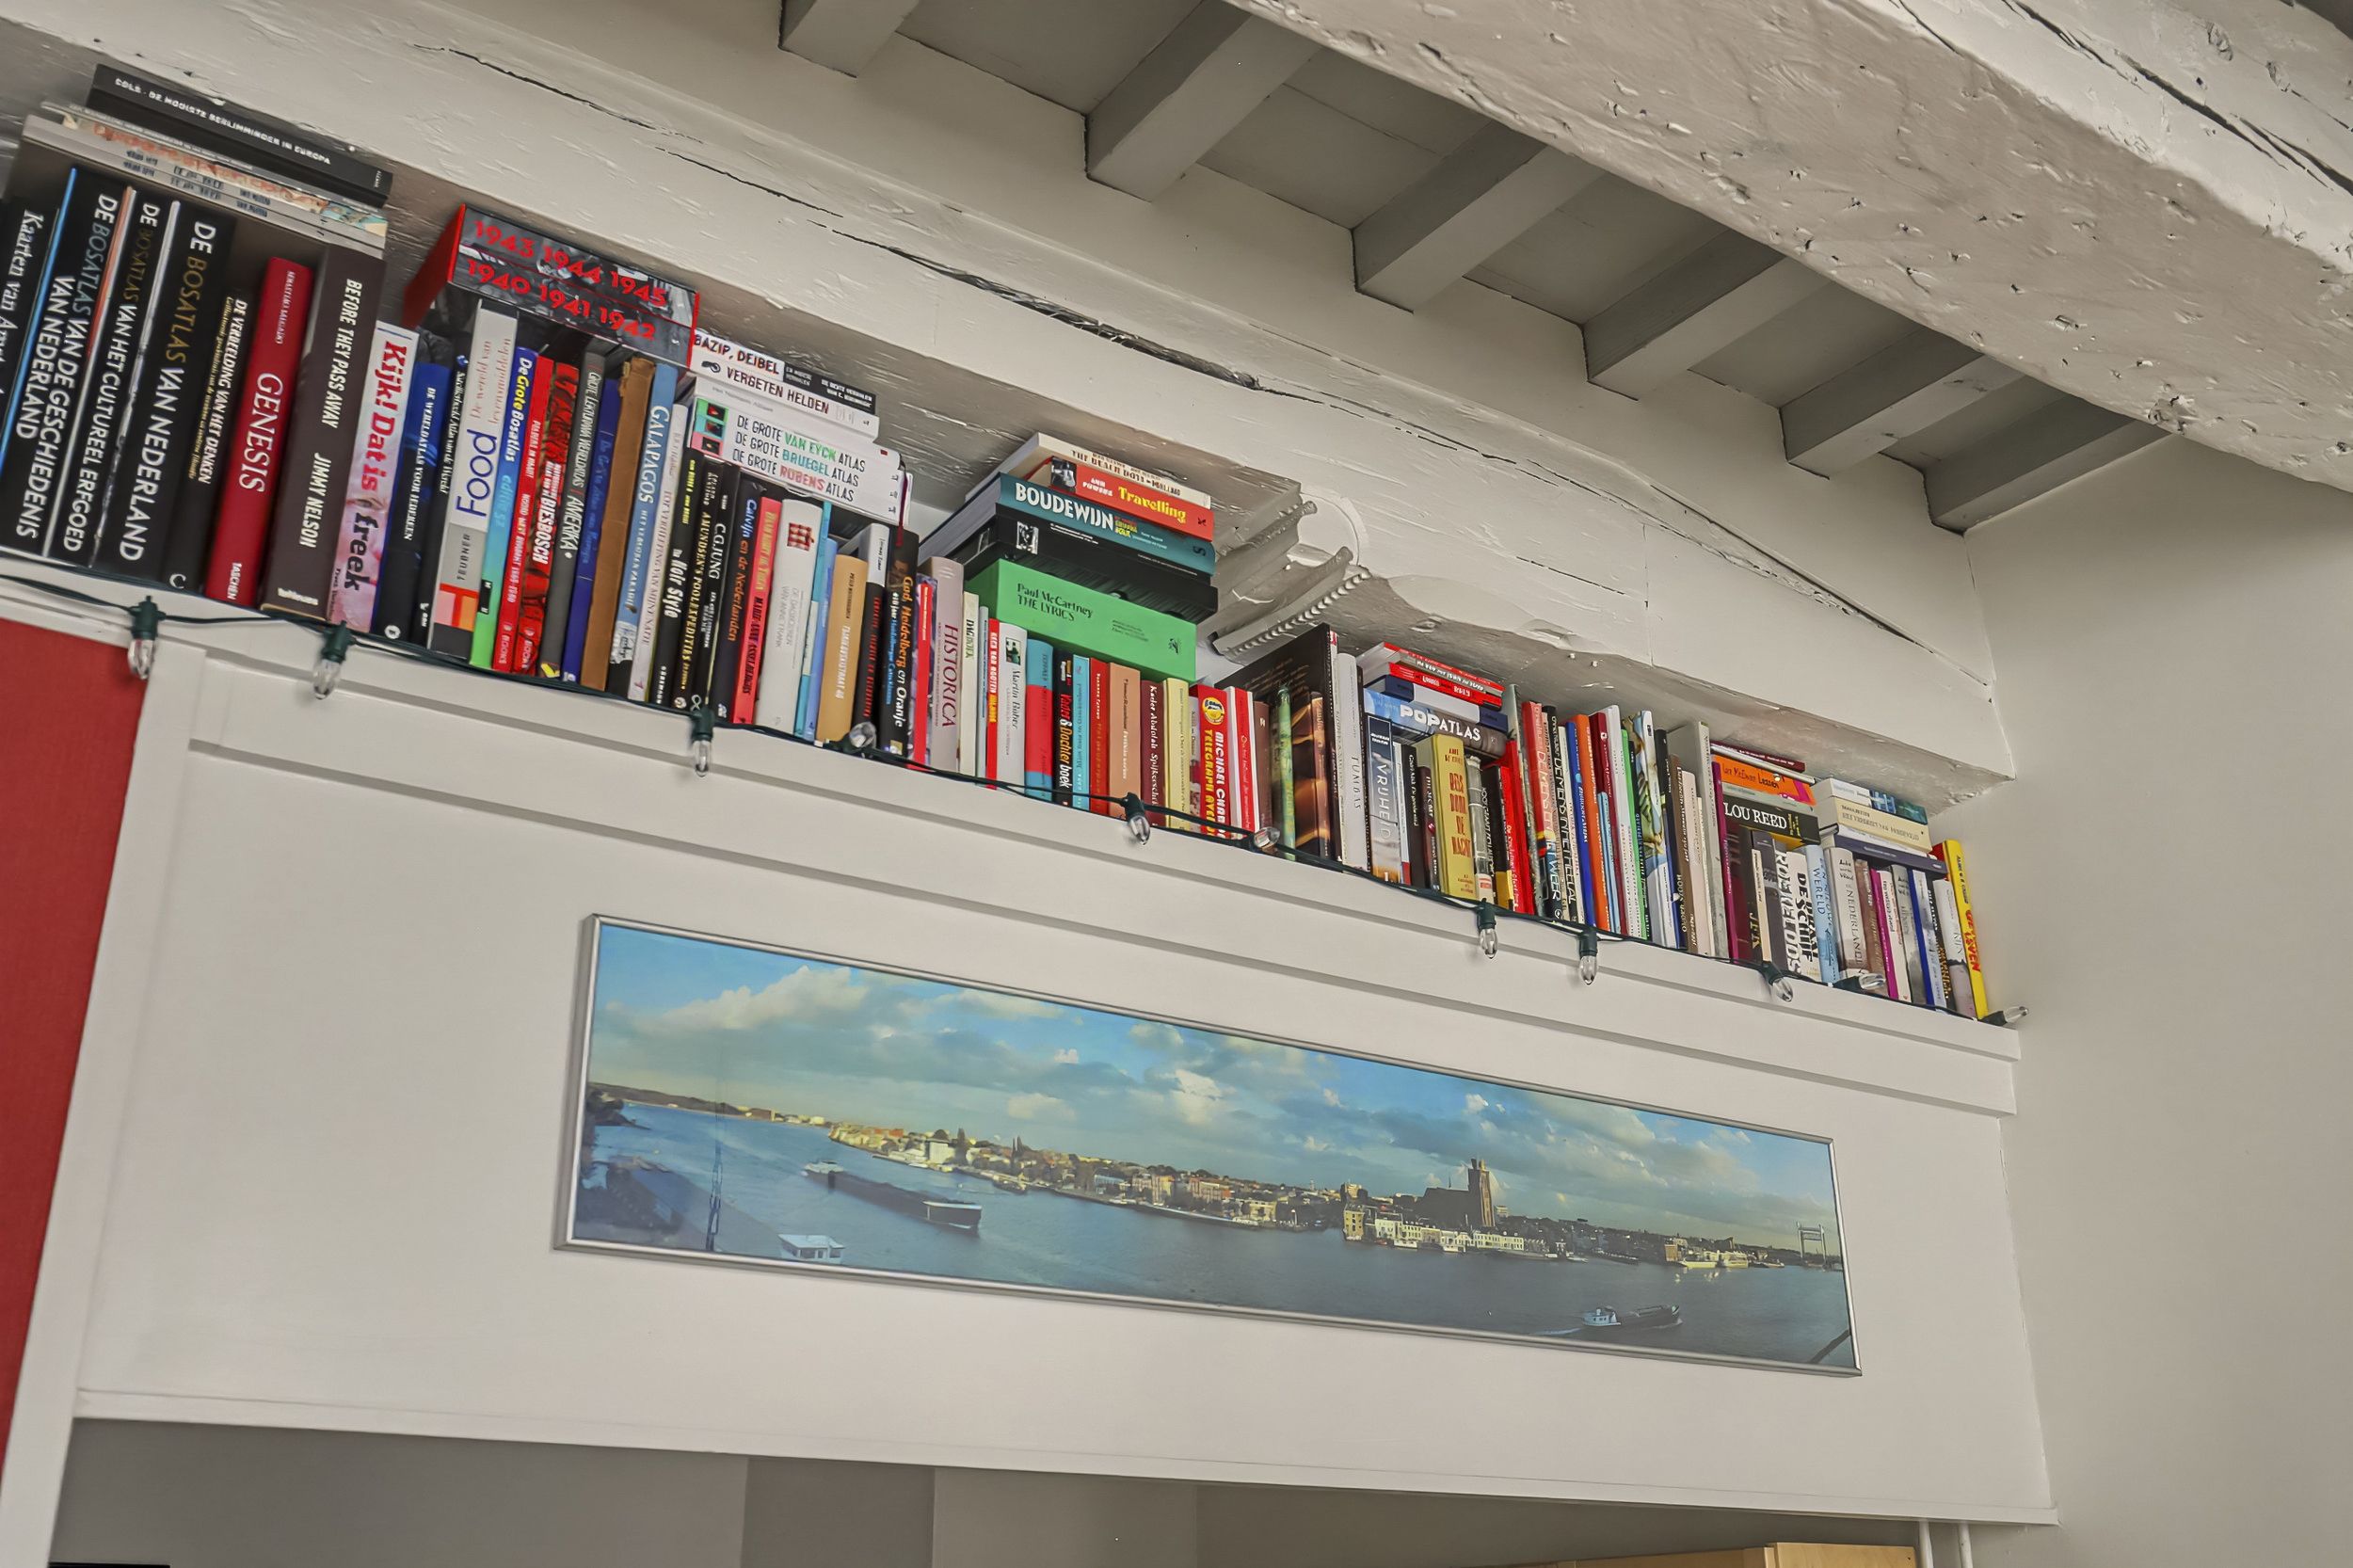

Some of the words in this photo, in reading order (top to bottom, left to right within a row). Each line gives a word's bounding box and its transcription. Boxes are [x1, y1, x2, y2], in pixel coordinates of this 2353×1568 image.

[294, 143, 331, 166] EUROPA
[94, 193, 118, 224] DE
[140, 202, 161, 228] DE
[8, 209, 44, 277] Kaarten
[189, 220, 216, 254] DE
[72, 222, 111, 316] BOSATLAS
[122, 228, 154, 302] BOSATLAS
[473, 220, 536, 259] 1943
[542, 246, 604, 283] 1944
[610, 269, 669, 308] 1945
[1, 281, 21, 311] van
[48, 275, 76, 314] VAN
[165, 256, 208, 363] BOSATLAS
[233, 298, 248, 314] DE
[340, 279, 362, 326] BEFORE
[467, 259, 532, 295] 1940
[538, 284, 590, 318] 1941
[598, 306, 656, 342] 1942
[62, 318, 90, 359] VAN
[116, 303, 137, 337] VAN
[106, 338, 130, 373] HET
[218, 313, 244, 390] VERBEELDING
[334, 328, 355, 358] THEY
[737, 349, 779, 376] DEIBEL
[16, 316, 64, 440] NEDERLAND
[53, 358, 79, 389] DE
[328, 357, 350, 392] PASS
[375, 341, 408, 411] Kijk!
[474, 363, 488, 400] wereld
[481, 342, 491, 360] van
[488, 338, 511, 424] levensmiddelen
[519, 358, 533, 376] De
[152, 367, 185, 412] VAN
[213, 392, 231, 411] VAN
[322, 391, 343, 428] AWAY
[426, 387, 437, 400] DE
[512, 376, 530, 411] Grote
[727, 366, 784, 398] VERGETEN
[787, 389, 829, 414] HELDEN
[82, 373, 121, 465] CULTUREEL
[209, 410, 225, 437] HET
[238, 373, 283, 493] GENESIS
[366, 412, 396, 462] Dat
[415, 400, 435, 471] WERELDATLAS
[504, 410, 524, 462] Bosatlas
[16, 389, 71, 539] GESCHIEDENIS
[198, 436, 219, 485] DENKEN
[572, 437, 592, 488] WERELDATLAS
[639, 406, 669, 504] GALAPAGOS
[735, 431, 747, 446] DE
[749, 438, 780, 458] GROTE
[782, 450, 830, 477] BRUEGEL
[831, 468, 859, 488] ATLAS
[737, 414, 749, 428] DE
[752, 420, 782, 442] GROTE
[783, 433, 807, 452] VAN
[808, 442, 837, 461] EYCK
[838, 452, 867, 472] ATLAS
[1071, 449, 1088, 462] THE
[119, 414, 174, 561] NEDERLAND
[309, 453, 331, 496] JIMMY
[361, 464, 387, 491] is
[410, 468, 423, 491] VOOR
[456, 428, 497, 518] Food
[732, 448, 744, 462] DE
[747, 454, 777, 476] GROTE
[779, 464, 825, 491] RUBENS
[825, 483, 855, 503] ATLAS
[63, 467, 98, 552] ERFGOED
[299, 496, 325, 548] NELSON
[404, 491, 419, 541] IEDEREEN
[559, 496, 585, 551] AMERIKA
[743, 499, 757, 538] Calvijn
[1015, 482, 1114, 532] BOUDEWIJN
[1118, 486, 1187, 524] Travelling
[344, 512, 378, 591] freek
[532, 496, 557, 565] BIESBOSCH
[696, 512, 711, 576] AMUNDSEN'S
[740, 539, 749, 555] en
[456, 534, 471, 581] TEUBNER
[668, 558, 688, 584] Noir
[738, 555, 748, 573] de
[227, 562, 242, 600] TASCHEN
[662, 584, 684, 618] Style
[1016, 583, 1040, 600] Paul
[1042, 591, 1094, 618] McCartney
[681, 576, 703, 661] POOLEXPEDITIES
[728, 572, 746, 642] Nederlanden
[1017, 595, 1038, 611] THE
[1040, 603, 1075, 622] LYRICS
[896, 605, 912, 668] Heidelberg
[896, 669, 905, 684] en
[942, 624, 958, 728] HISTORICA
[893, 687, 907, 728] Oranje
[1400, 703, 1481, 742] POPATLAS
[1060, 726, 1072, 764] Dochter
[1150, 712, 1159, 749] Abdolah
[1060, 763, 1072, 789] boek
[1205, 729, 1214, 792] TELEGRAPH
[1215, 731, 1225, 785] MICHAEL
[1538, 751, 1547, 770] DE
[1554, 757, 1562, 776] DE
[1376, 764, 1391, 839] VRIJHEID
[1540, 769, 1551, 810] MENS
[1556, 776, 1566, 814] MENS
[1723, 802, 1750, 821] LOU
[1753, 807, 1787, 830] REED
[1547, 857, 1561, 900] WEER
[1563, 858, 1577, 904] HEELAL
[1797, 872, 1808, 894] DE
[1813, 868, 1825, 915] WERELD
